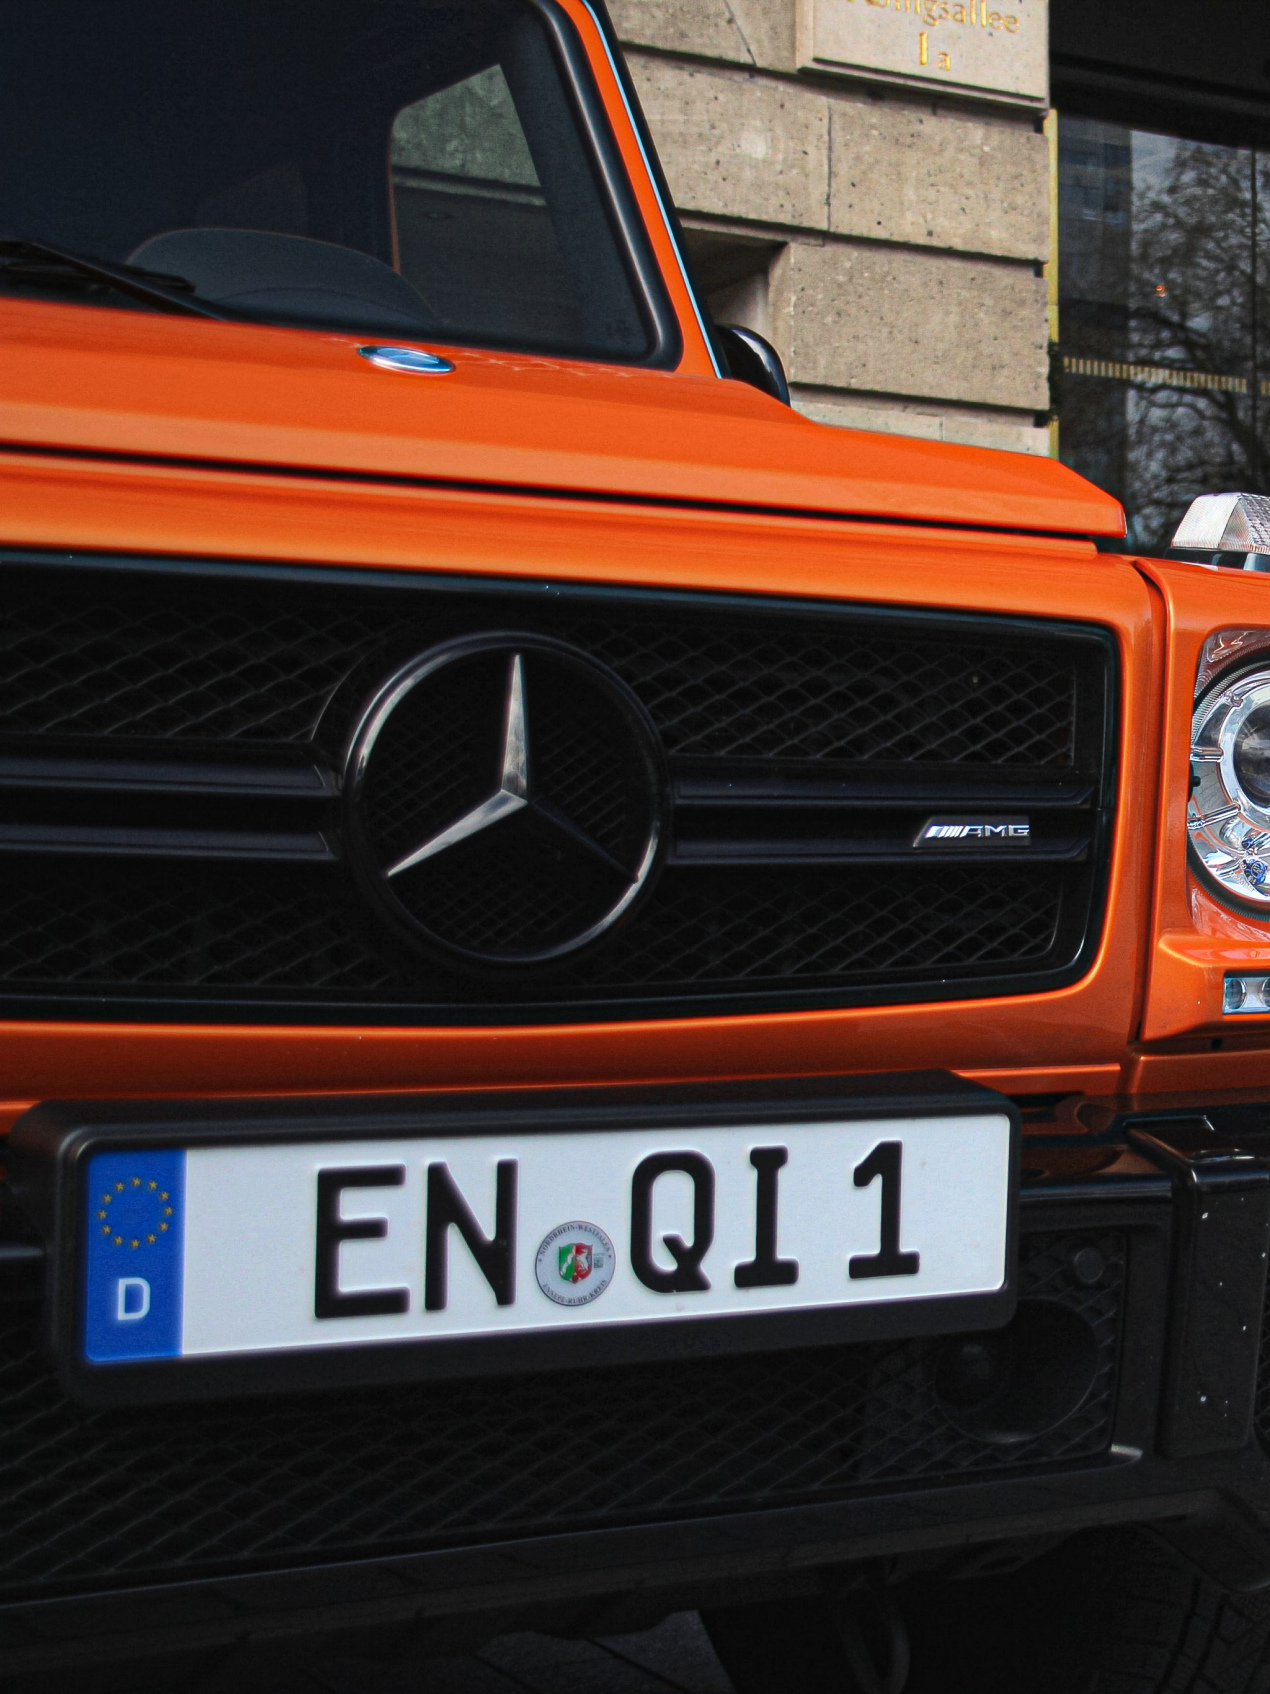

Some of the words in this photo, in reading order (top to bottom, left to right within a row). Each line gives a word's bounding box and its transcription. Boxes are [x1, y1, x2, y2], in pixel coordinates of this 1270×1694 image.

[959, 824, 1030, 838] AMG
[315, 1160, 518, 1320] EN
[630, 1147, 799, 1294] QI
[848, 1141, 920, 1280] 1
[116, 1277, 151, 1321] D
